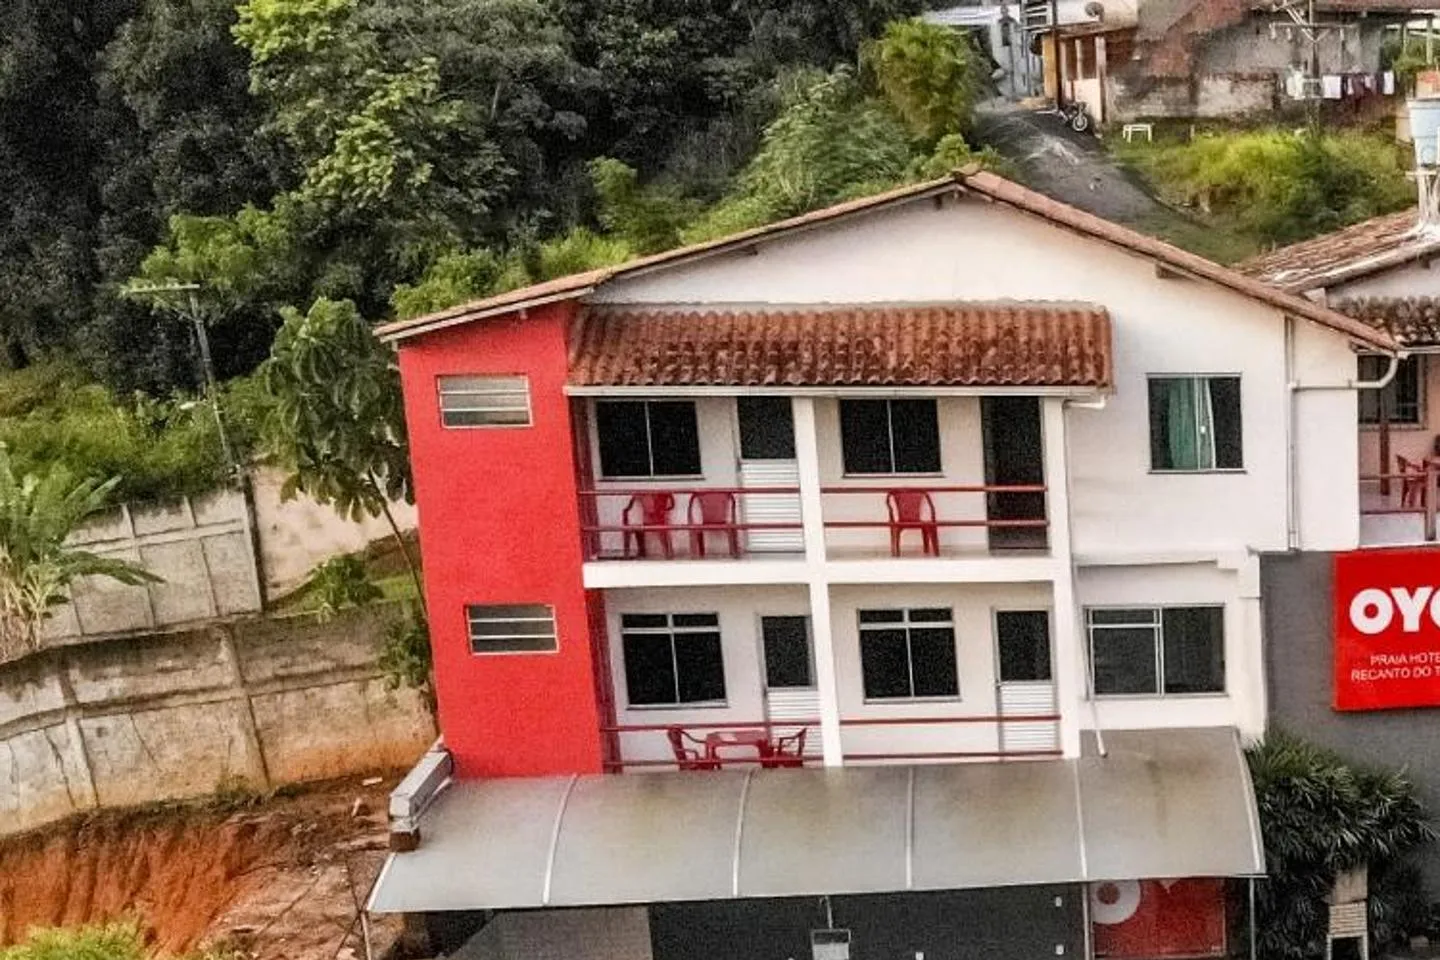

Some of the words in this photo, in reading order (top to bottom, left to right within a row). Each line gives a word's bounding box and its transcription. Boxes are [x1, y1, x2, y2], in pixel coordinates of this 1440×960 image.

[1370, 654, 1408, 666] PRAIA
[1351, 667, 1411, 681] RECANTO
[1412, 665, 1432, 678] DO
